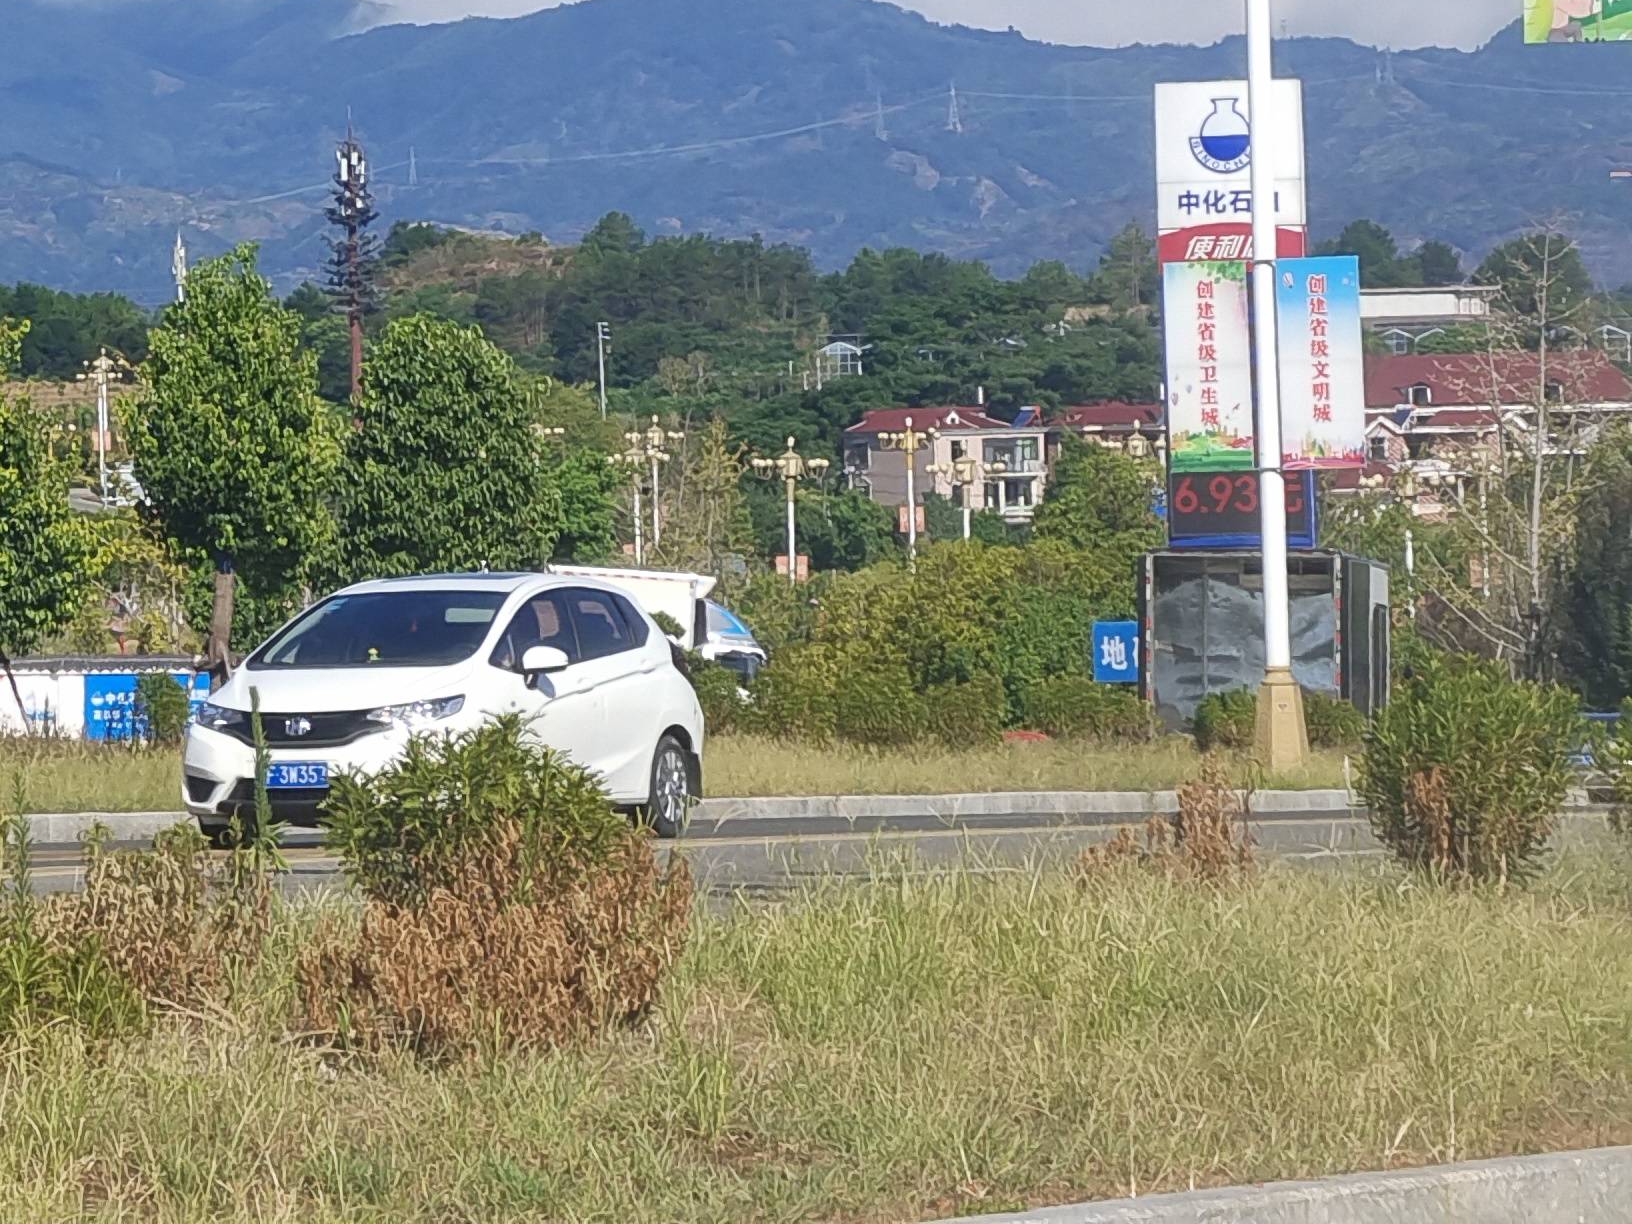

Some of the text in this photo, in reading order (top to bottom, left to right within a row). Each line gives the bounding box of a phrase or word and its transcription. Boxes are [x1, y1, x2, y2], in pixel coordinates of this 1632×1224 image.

[1191, 140, 1251, 171] SINOCH
[1177, 189, 1280, 215] 中化石
[1197, 279, 1219, 426] 创建省级卫生城
[1308, 275, 1332, 423] 创建省级文明城
[1100, 635, 1139, 671] 地
